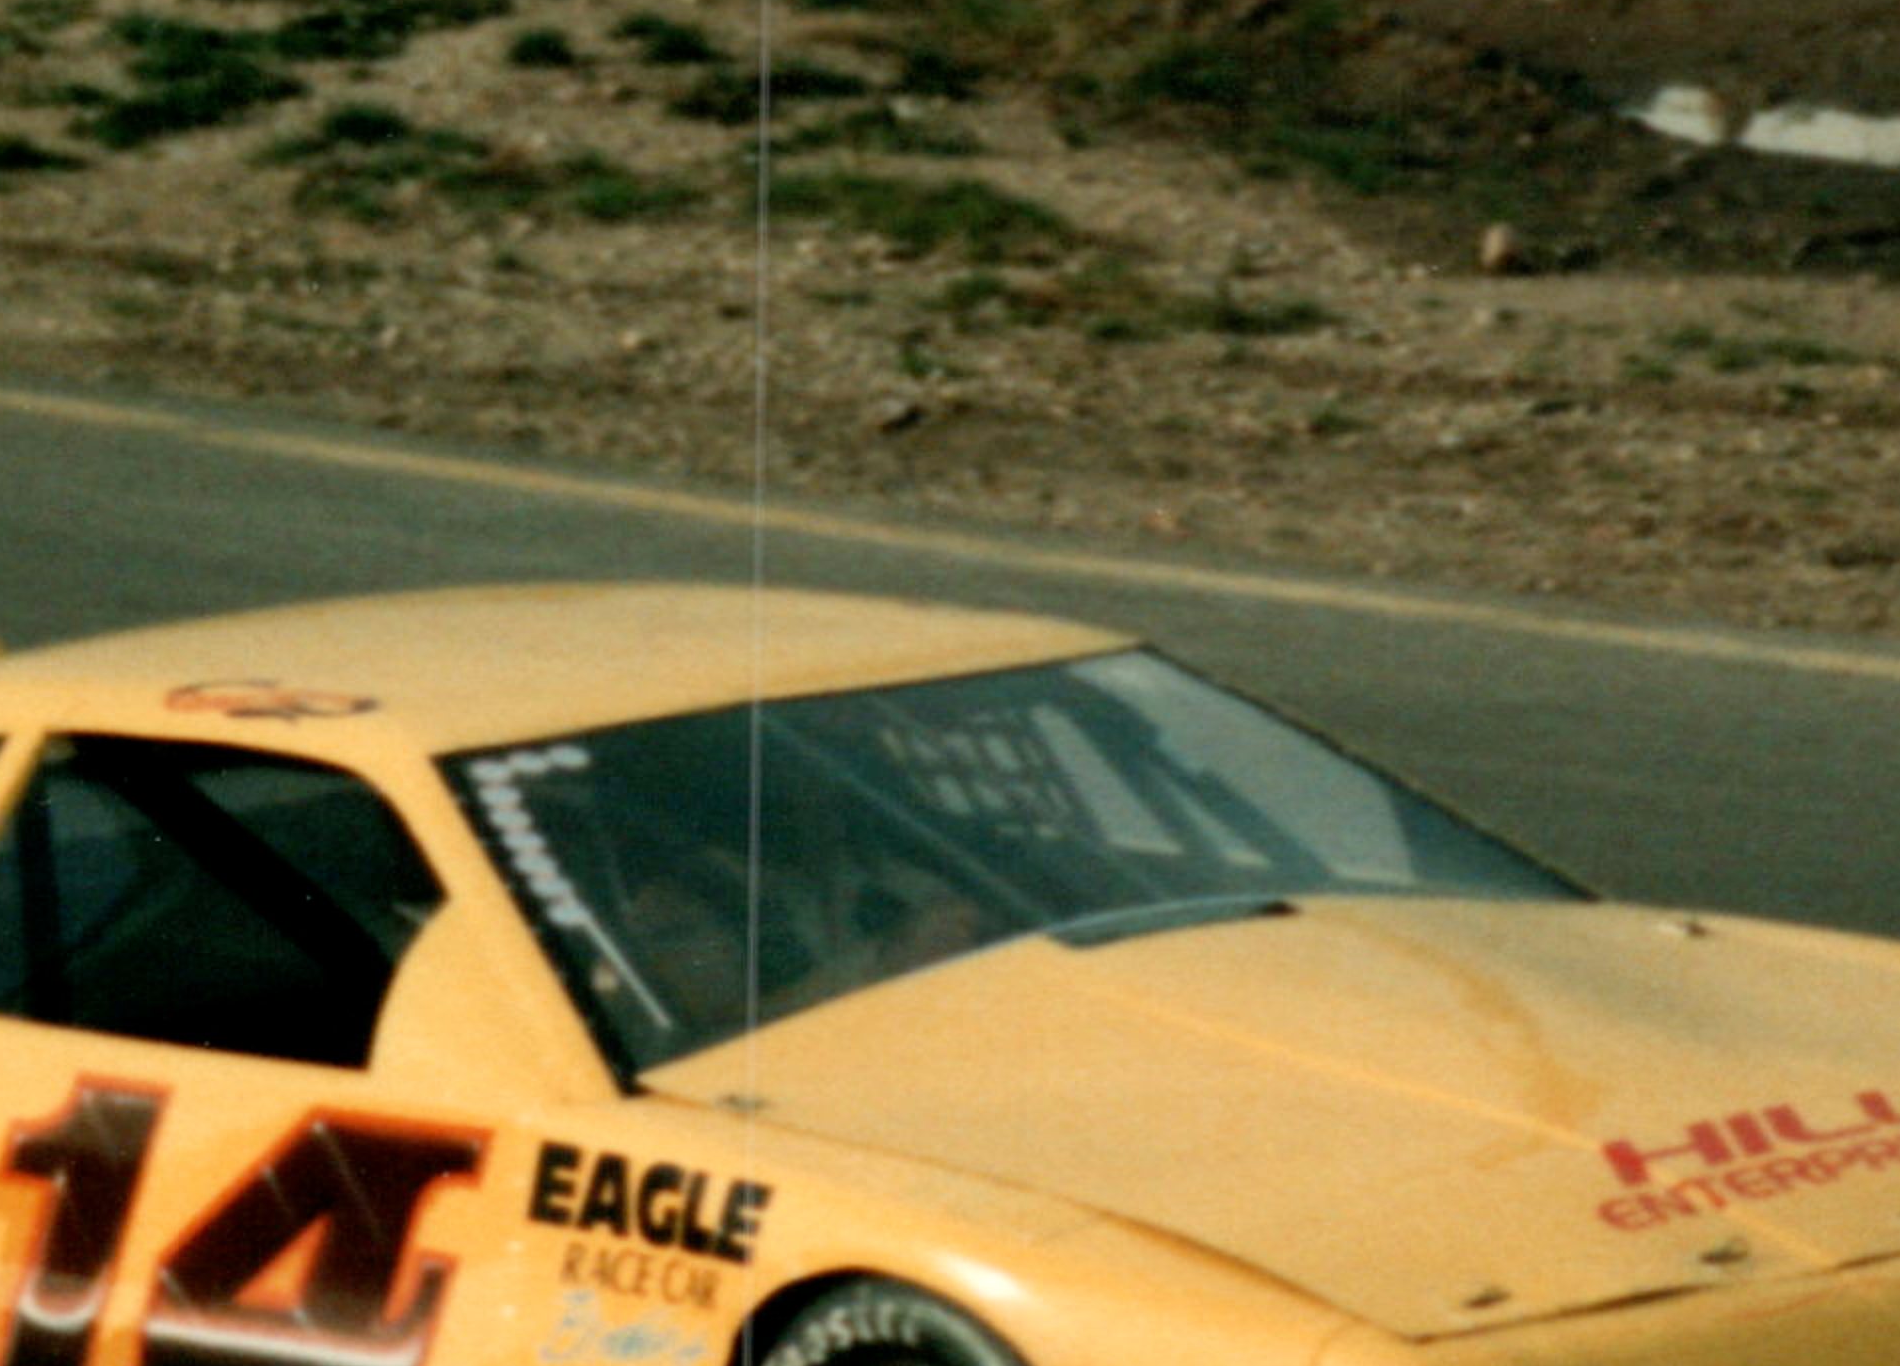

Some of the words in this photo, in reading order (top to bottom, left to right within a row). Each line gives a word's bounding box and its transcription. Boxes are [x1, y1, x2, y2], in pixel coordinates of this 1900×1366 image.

[526, 1139, 775, 1266] EAGLE
[558, 1240, 652, 1299] RACE
[660, 1258, 721, 1311] CAR
